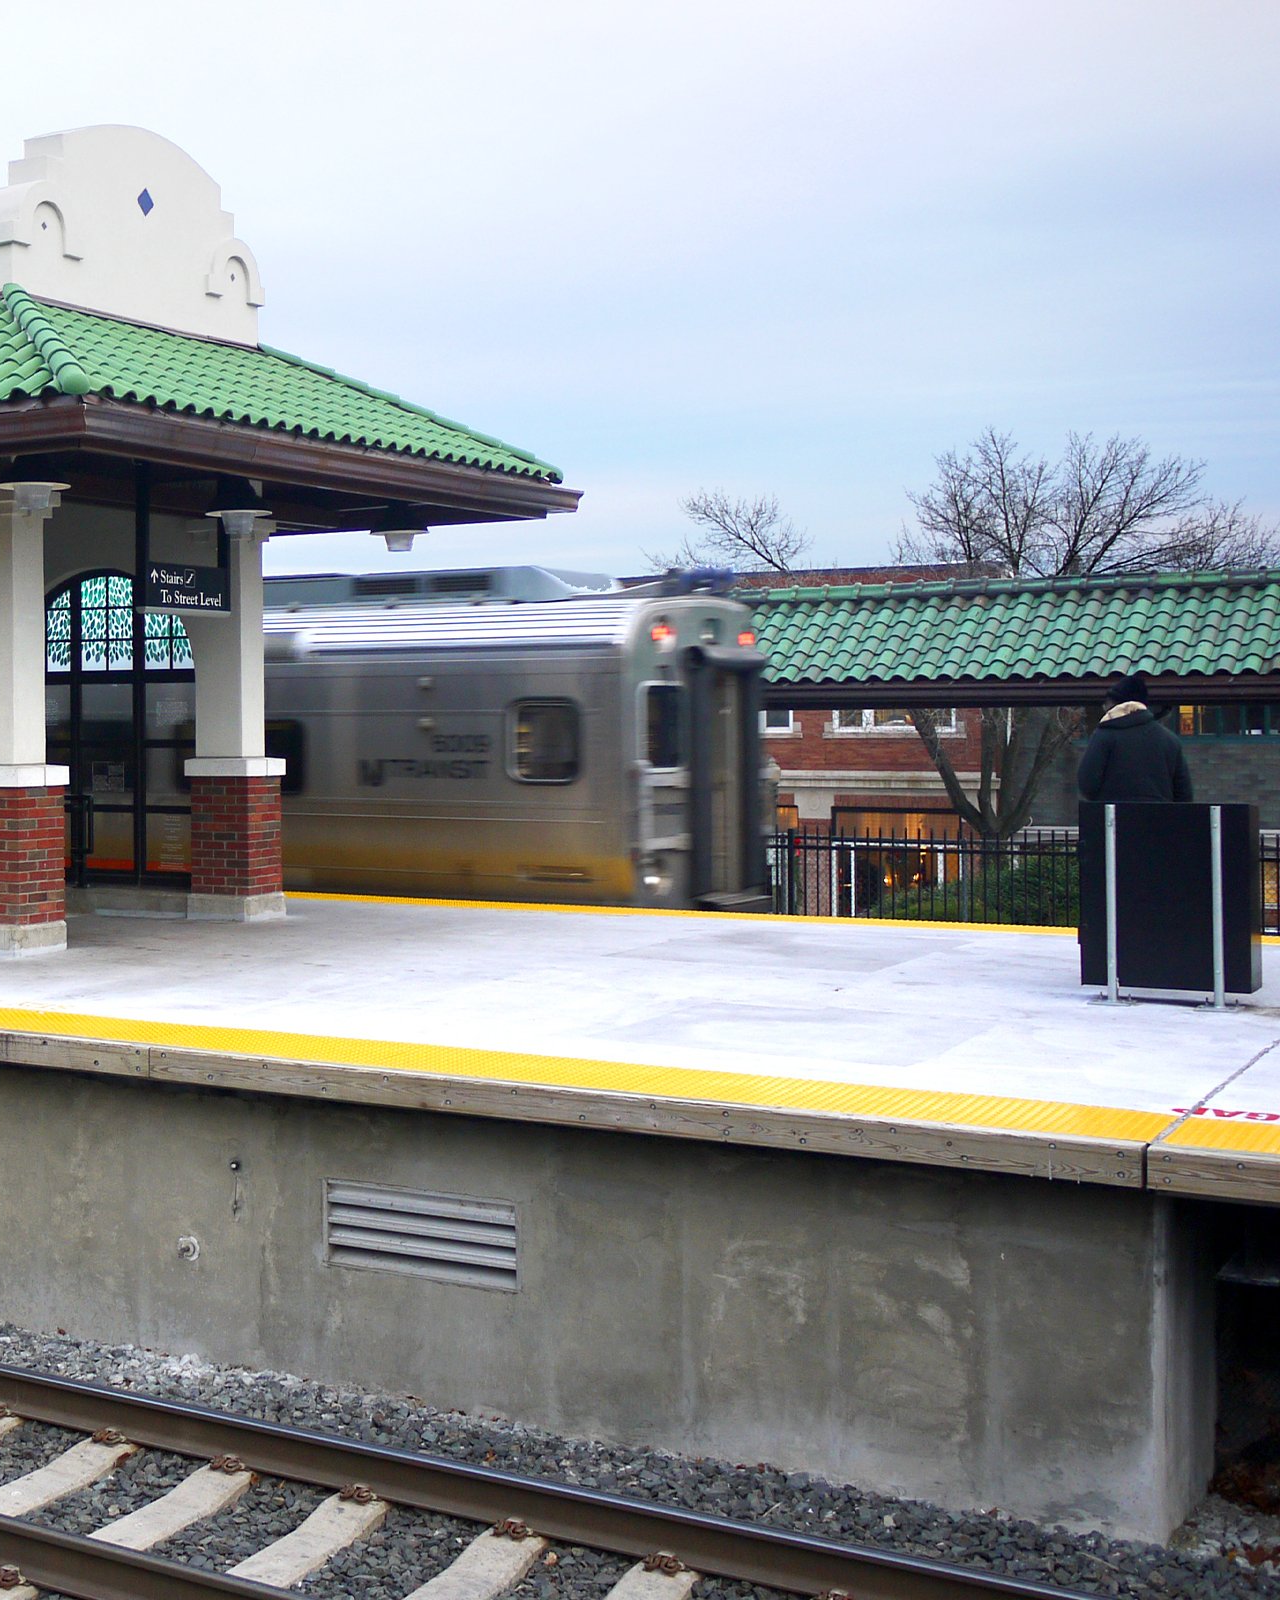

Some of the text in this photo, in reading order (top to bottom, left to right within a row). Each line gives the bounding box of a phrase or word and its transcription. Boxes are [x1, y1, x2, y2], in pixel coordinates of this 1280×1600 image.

[160, 569, 184, 585] Stairs
[160, 589, 222, 607] To Street Level
[1171, 1107, 1280, 1122] GAP
